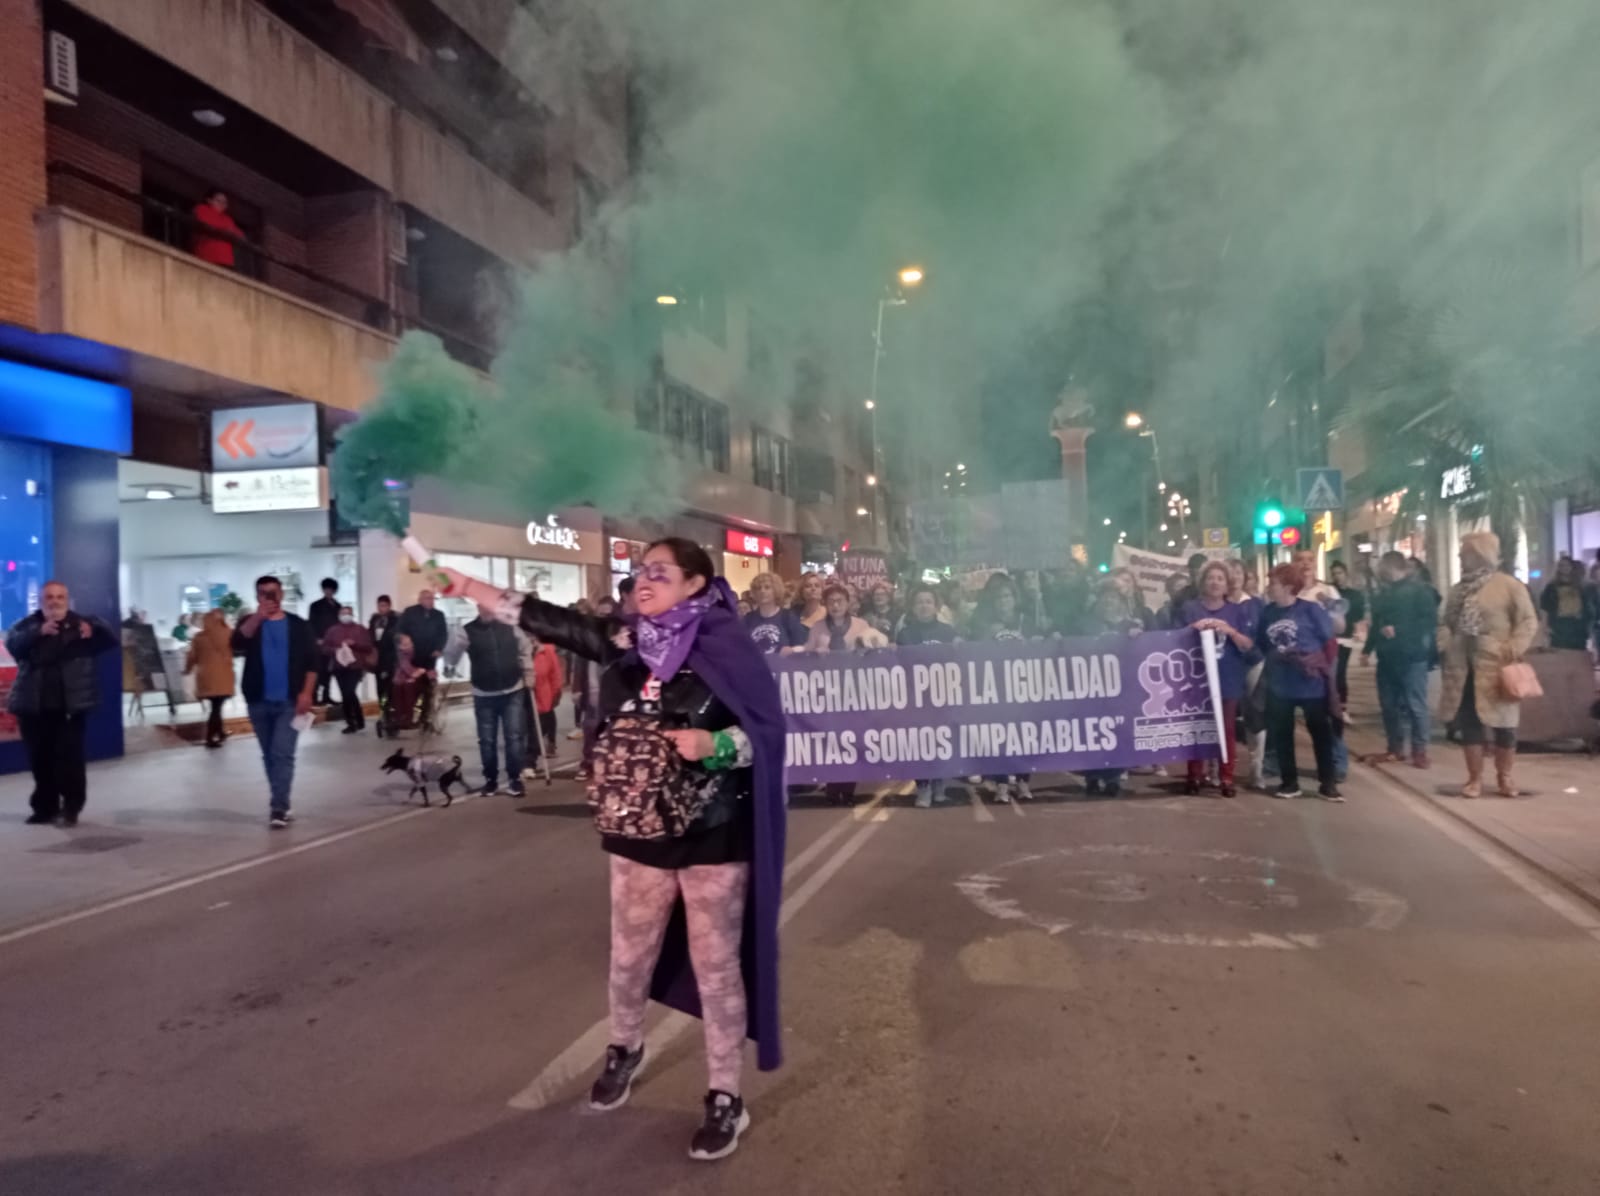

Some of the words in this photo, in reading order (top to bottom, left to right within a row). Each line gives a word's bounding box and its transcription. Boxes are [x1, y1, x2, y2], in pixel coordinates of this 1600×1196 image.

[860, 557, 888, 574] UNA
[772, 665, 908, 714] ARCHANDO
[913, 661, 963, 708] POR
[968, 659, 999, 705] LA
[1004, 654, 1121, 703] IGUALDAD
[864, 725, 953, 764] SOMOS
